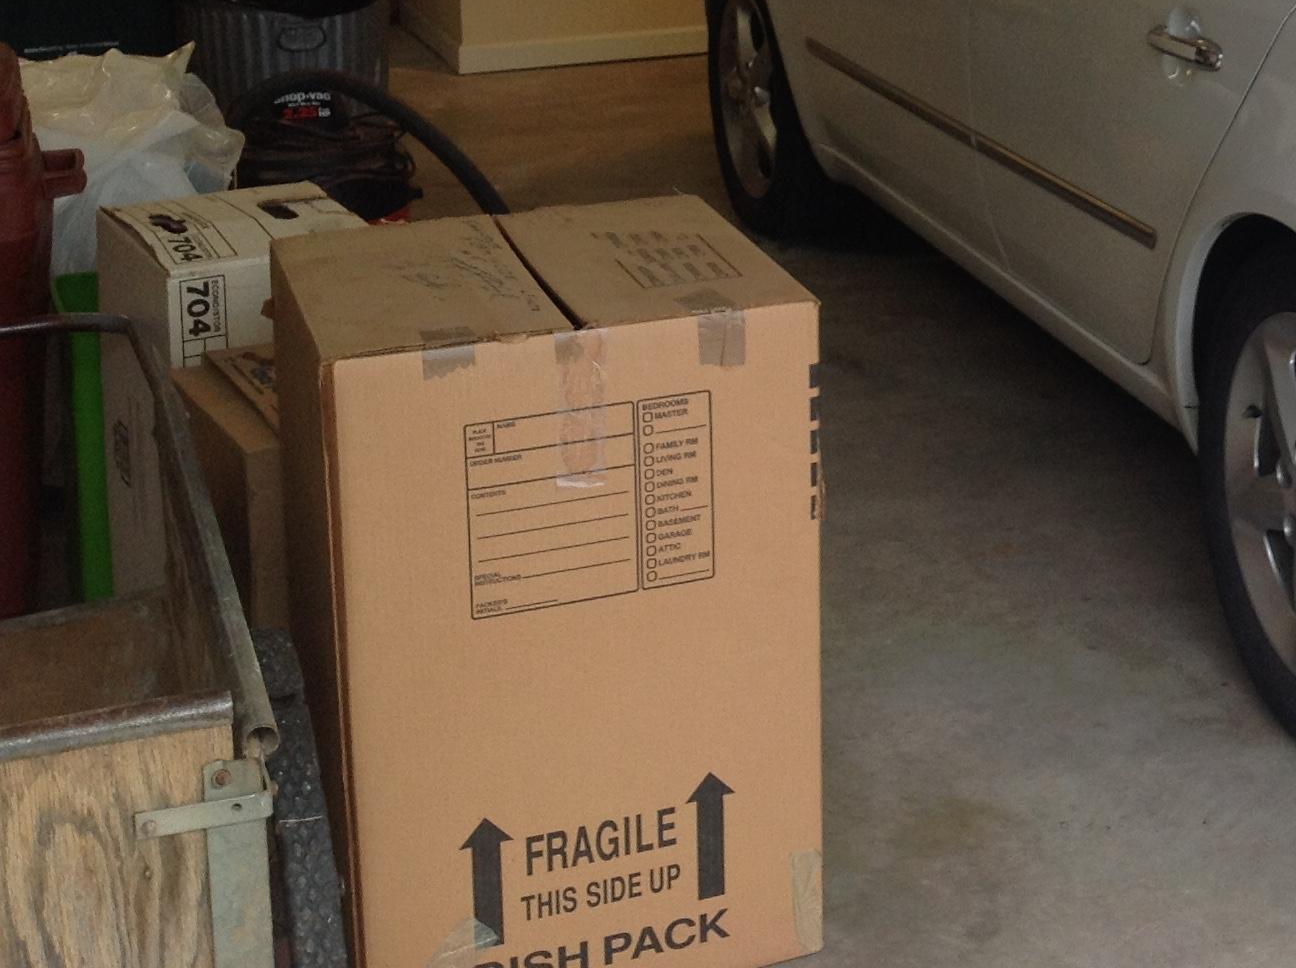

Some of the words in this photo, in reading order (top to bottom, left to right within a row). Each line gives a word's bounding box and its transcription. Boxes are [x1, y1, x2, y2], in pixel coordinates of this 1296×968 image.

[168, 235, 203, 263] 704
[186, 281, 211, 337] 704
[642, 398, 689, 411] BEDROOMS
[655, 408, 689, 419] MASTER
[656, 439, 684, 450] FAMILY
[656, 452, 682, 463] LIVING
[657, 490, 692, 501] KITCHEN
[657, 504, 679, 515] BATH
[658, 514, 701, 528] BASEMENT
[658, 528, 693, 541] GARAGE
[658, 542, 681, 553] ATTIC
[658, 553, 696, 567] LAUNDRY
[525, 806, 678, 877] FRAGILE
[521, 886, 577, 921] THIS
[586, 872, 642, 908] SIDE
[649, 863, 681, 893] UP
[473, 940, 589, 968] SH
[604, 908, 731, 966] PACK
